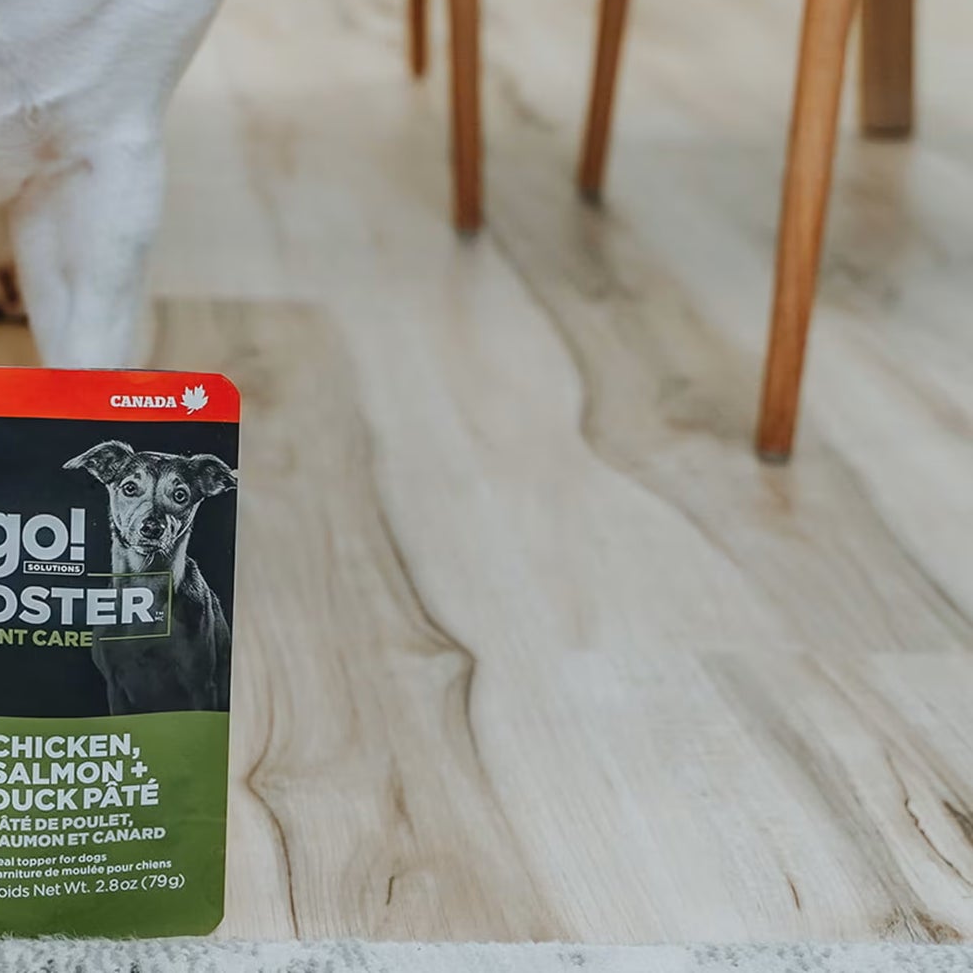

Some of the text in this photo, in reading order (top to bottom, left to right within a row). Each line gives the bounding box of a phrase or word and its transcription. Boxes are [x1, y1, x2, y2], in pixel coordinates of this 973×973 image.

[110, 395, 177, 409] CANADA
[27, 563, 81, 574] SOLUTIONS
[32, 629, 93, 647] CARE
[130, 761, 148, 778] +
[83, 778, 159, 809] PÂTÉ
[34, 817, 58, 831] DE
[62, 813, 134, 830] POULET,
[68, 832, 89, 846] ET
[92, 827, 166, 844] CANARD
[17, 856, 57, 869] topper
[59, 854, 76, 865] for
[78, 852, 107, 866] dogs
[44, 866, 59, 877] de
[61, 864, 105, 876] moulée
[106, 863, 134, 876] pour
[136, 859, 172, 871] chiens
[33, 883, 61, 897] Net
[63, 880, 91, 894] Wt.
[141, 873, 186, 891] (79g)
